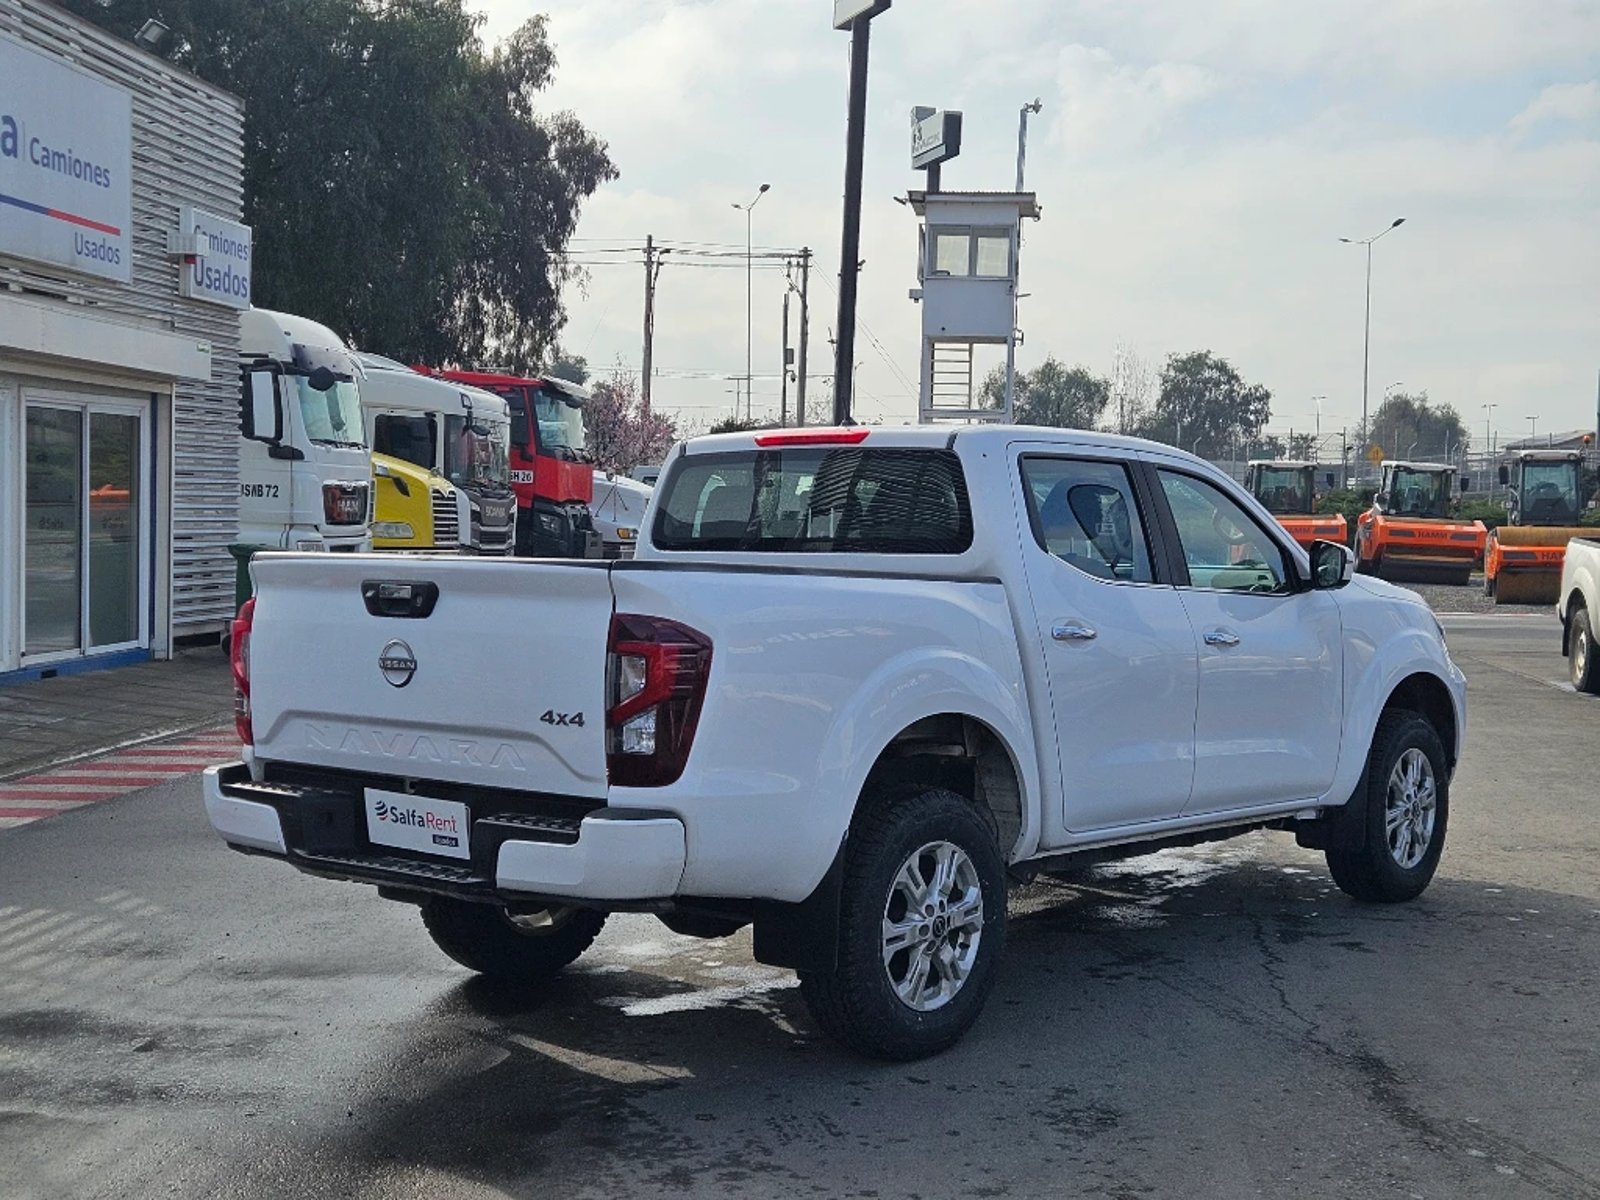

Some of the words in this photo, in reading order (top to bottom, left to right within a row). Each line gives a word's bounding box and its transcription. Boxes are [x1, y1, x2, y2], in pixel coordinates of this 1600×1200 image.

[30, 137, 111, 188] Camiones
[74, 231, 121, 265] Usados
[194, 258, 248, 298] Usados
[265, 484, 279, 498] 72
[1417, 531, 1448, 541] HAMM
[379, 659, 415, 670] NISSAN
[539, 709, 586, 728] 4x4
[304, 722, 527, 772] NAVARA
[389, 805, 459, 834] SalfaRent
